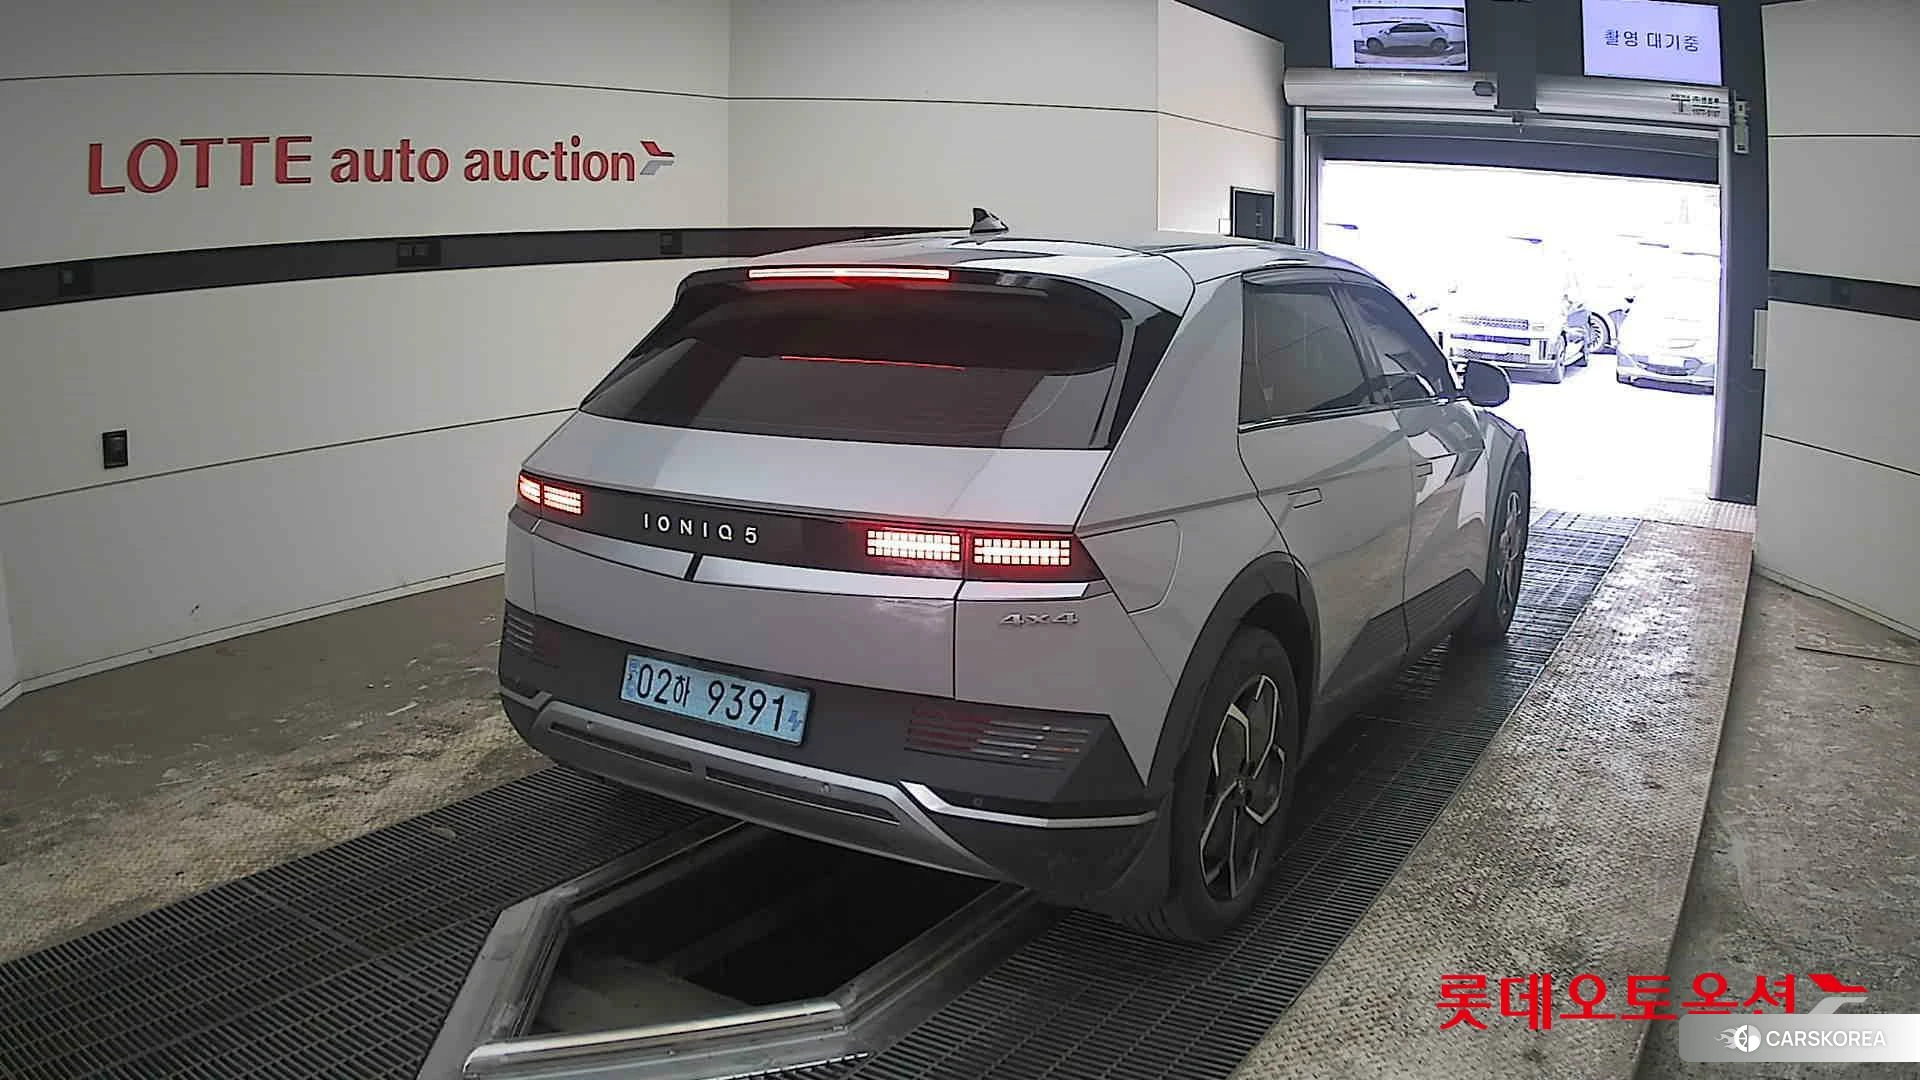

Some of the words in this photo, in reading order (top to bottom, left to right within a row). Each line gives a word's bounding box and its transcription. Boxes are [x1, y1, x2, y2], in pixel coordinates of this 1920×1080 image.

[1646, 32, 1699, 52] 대기중
[87, 135, 312, 195] LOTTE
[329, 138, 449, 183] auto
[463, 135, 636, 183] auction
[642, 512, 734, 541] IONIQ
[744, 526, 759, 545] 5
[637, 663, 691, 708] 02하
[707, 680, 785, 732] 9391
